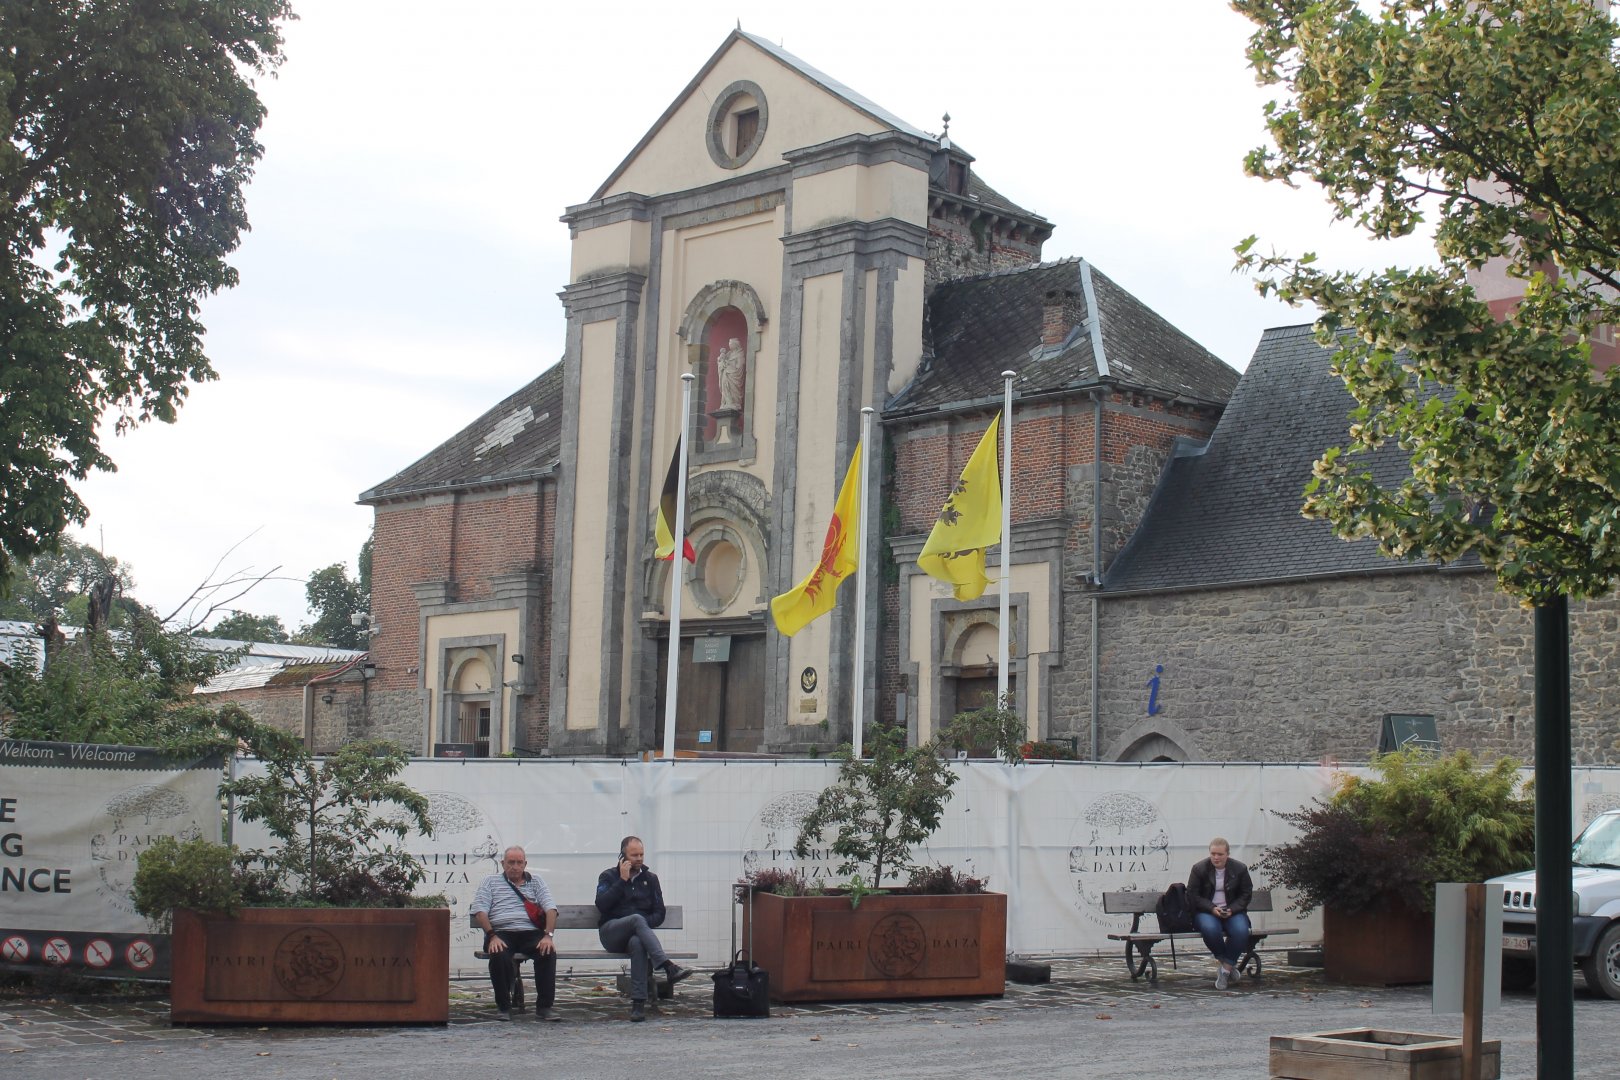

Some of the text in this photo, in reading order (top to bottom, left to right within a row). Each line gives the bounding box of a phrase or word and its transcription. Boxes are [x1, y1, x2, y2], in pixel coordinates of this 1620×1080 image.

[0, 742, 53, 758] Welkom
[71, 745, 136, 761] Welcome
[119, 834, 175, 845] PAI
[772, 849, 830, 860] PARI
[1095, 845, 1146, 856] PAIRI
[418, 853, 467, 865] AIRI
[1093, 861, 1147, 872] DAIZA
[417, 871, 470, 883] AIZA
[816, 938, 978, 951] PAIRI DAIZA
[210, 955, 413, 968] PAIRI DAIZA
